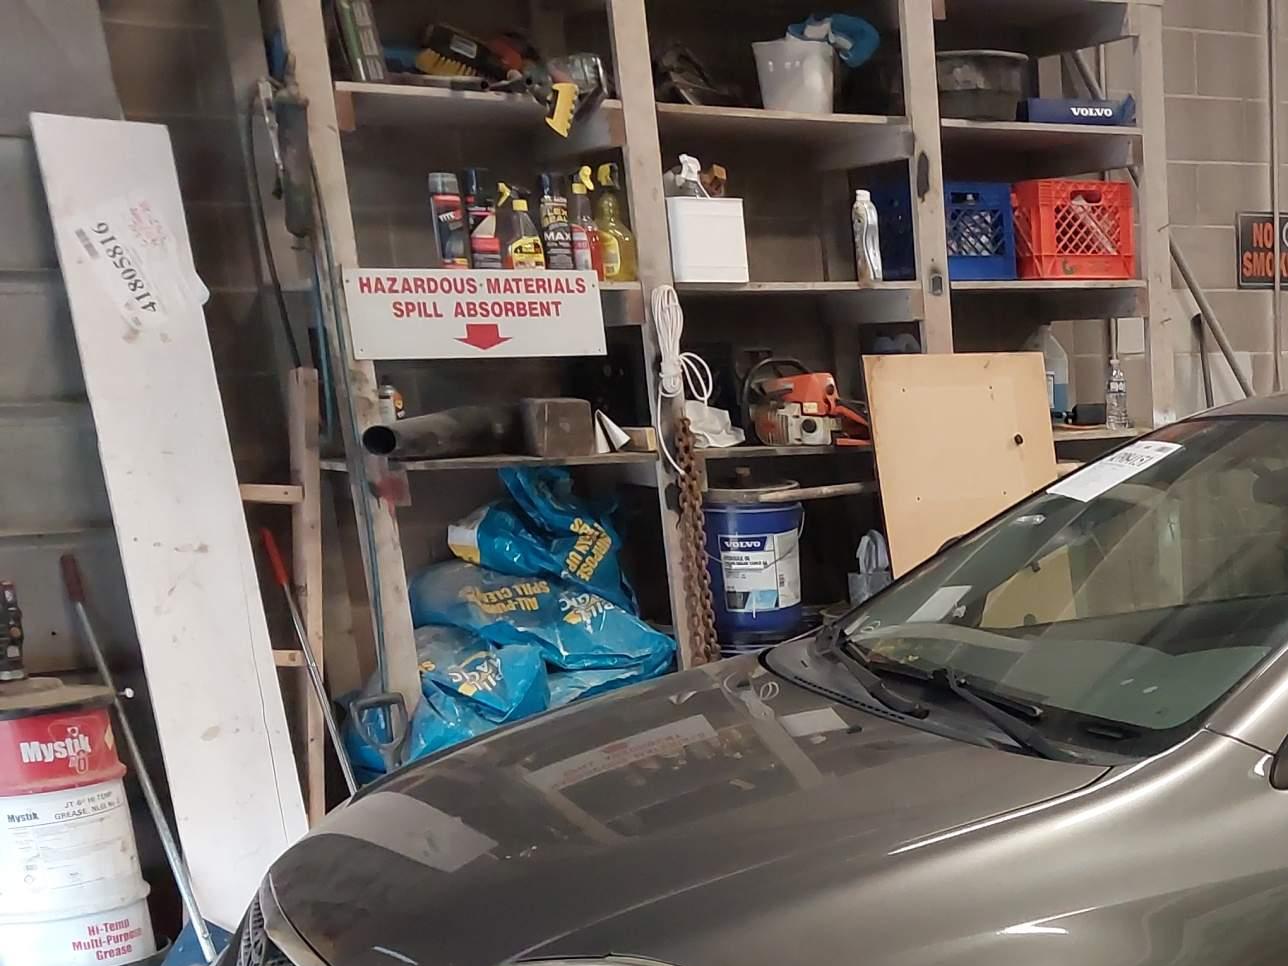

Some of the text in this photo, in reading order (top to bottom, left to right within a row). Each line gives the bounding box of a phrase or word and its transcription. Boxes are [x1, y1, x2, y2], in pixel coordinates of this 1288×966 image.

[1070, 107, 1113, 117] VOLVO
[544, 230, 572, 241] MAX
[1252, 222, 1274, 249] NO
[92, 222, 157, 312] 41805816
[358, 276, 587, 295] HAZARDOUS MATERIALS
[392, 301, 563, 318] SPILL ABSORBENT
[512, 580, 550, 596] SPILL
[20, 728, 92, 764] Mystik
[7, 811, 40, 823] Mystik
[87, 918, 130, 938] Hi-Temp
[95, 943, 133, 961] Grease
